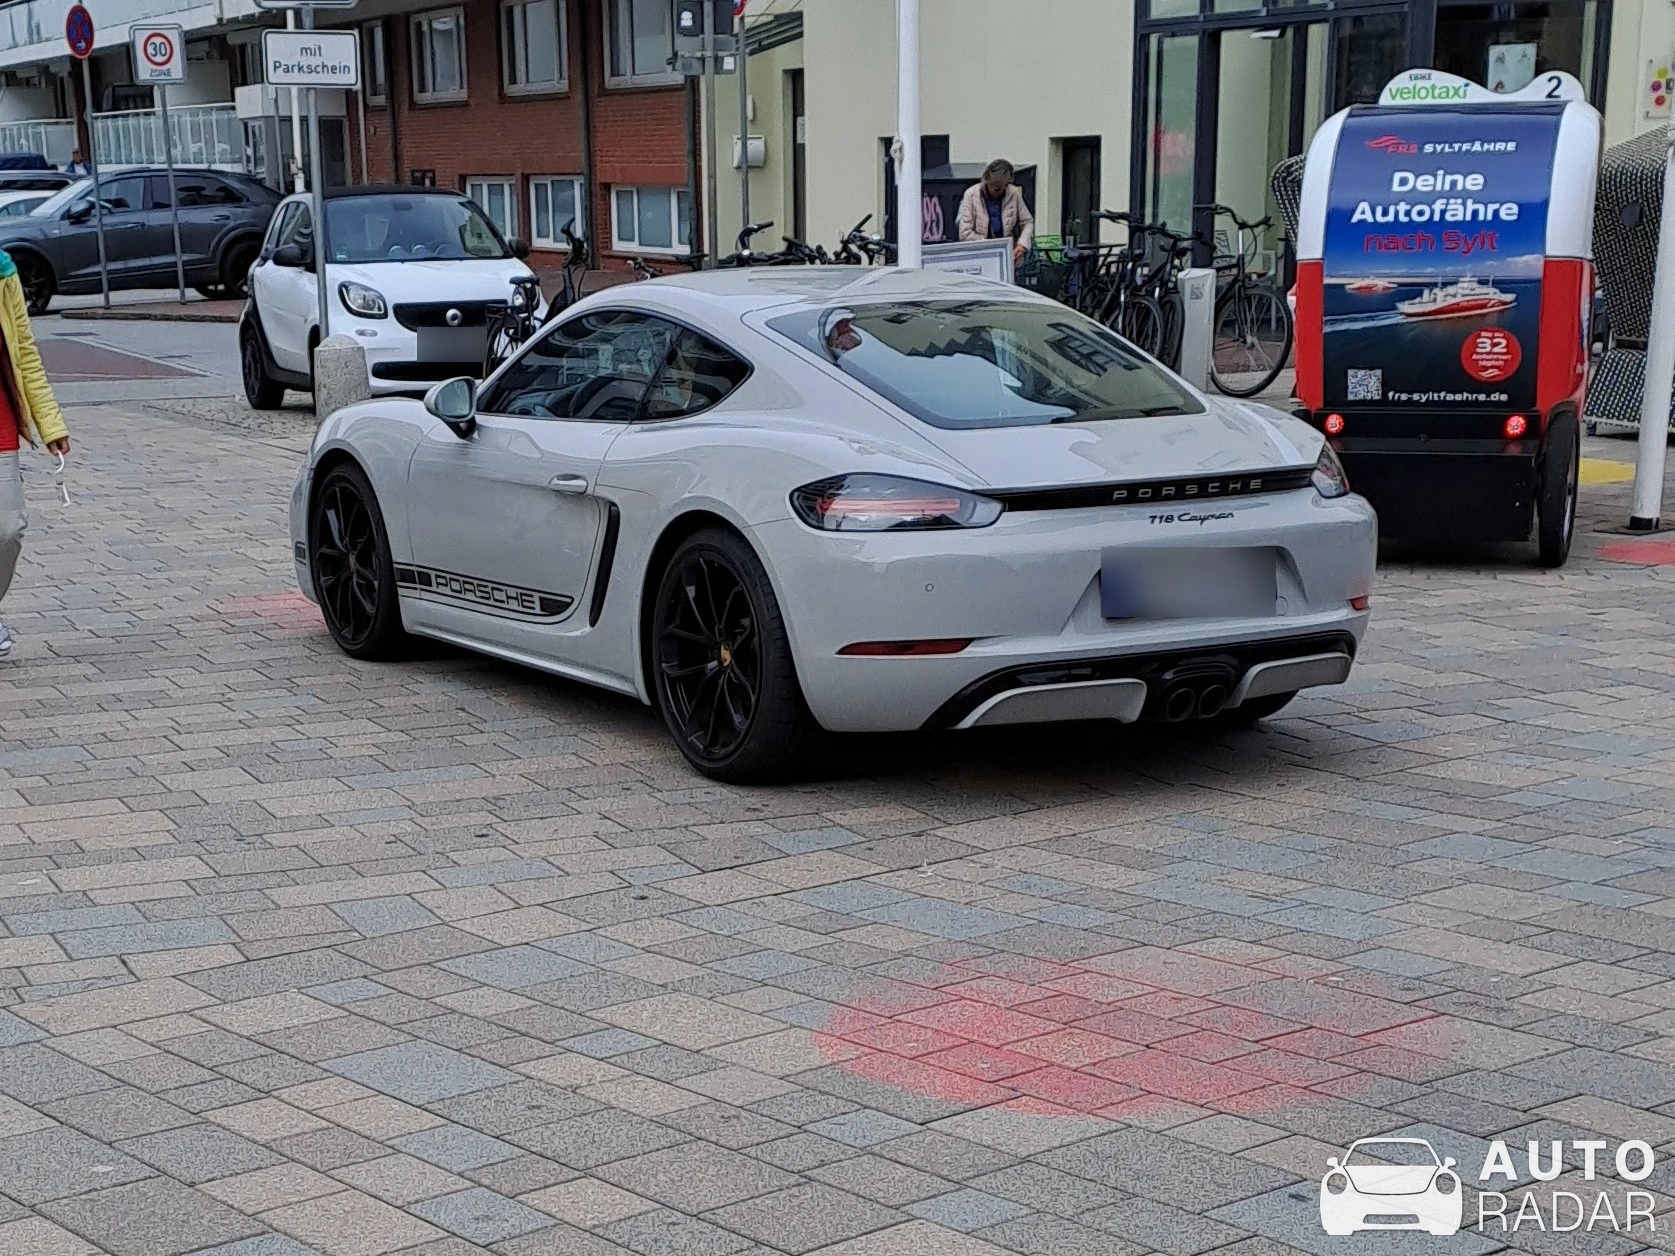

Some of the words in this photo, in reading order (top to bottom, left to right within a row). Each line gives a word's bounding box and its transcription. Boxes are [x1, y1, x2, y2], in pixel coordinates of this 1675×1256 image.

[149, 41, 168, 58] 30
[299, 43, 323, 57] mit
[273, 60, 351, 75] Parkschein
[1388, 82, 1470, 101] velotaxi
[1544, 75, 1562, 99] 2
[1387, 142, 1418, 154] FRS
[1423, 140, 1517, 154] SYLTFÄHRE
[1391, 169, 1485, 192] Deine
[1350, 198, 1520, 223] Autofähre
[1364, 230, 1436, 253] nach
[1442, 229, 1499, 257] Sylt
[1475, 337, 1508, 353] 32
[1387, 390, 1509, 403] frs-syltfaehre.de
[1112, 478, 1264, 500] PORSCHE
[1149, 514, 1175, 524] 718
[1177, 512, 1235, 526] Cayman
[433, 573, 537, 611] PORSCHE
